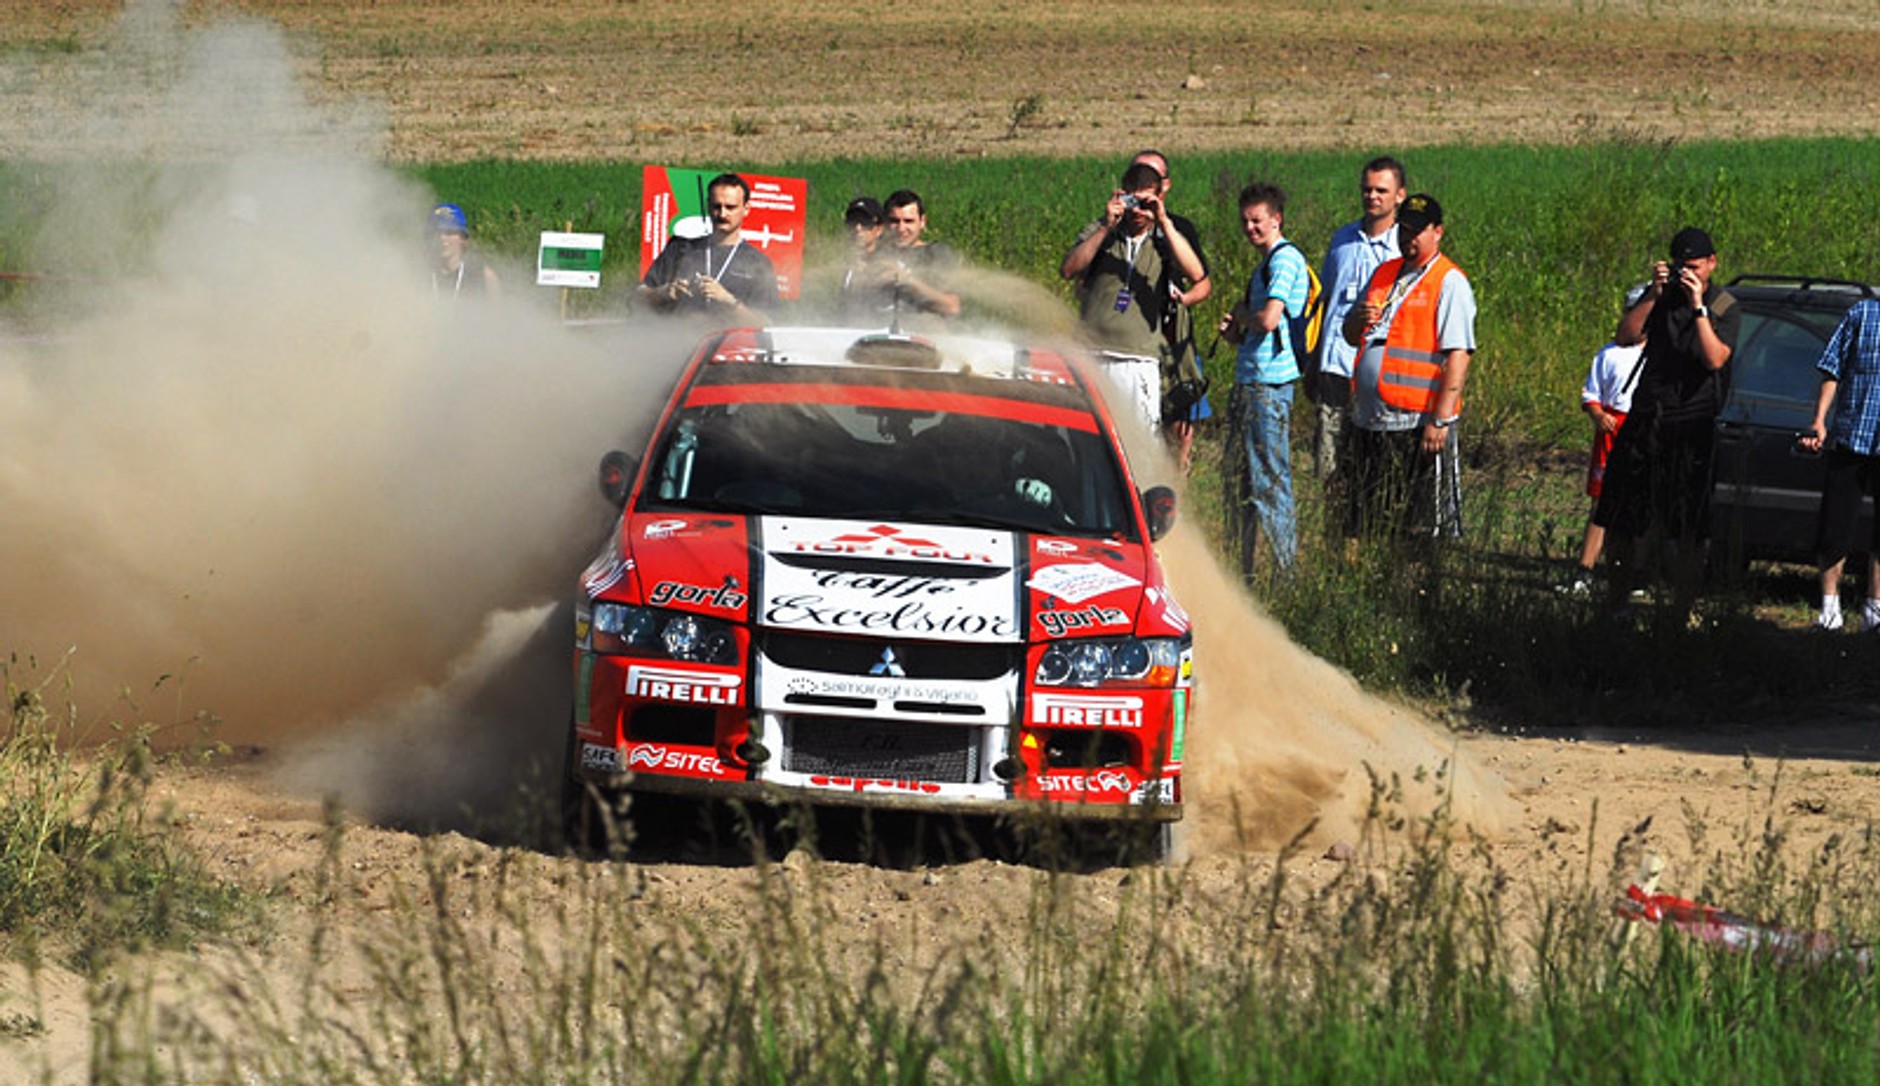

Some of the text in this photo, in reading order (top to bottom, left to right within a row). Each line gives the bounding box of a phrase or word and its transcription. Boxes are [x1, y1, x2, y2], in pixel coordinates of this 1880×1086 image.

[787, 541, 993, 564] TOP FOUR
[650, 577, 748, 611] gorla
[765, 594, 1018, 637] Excelsior
[1036, 605, 1132, 637] gorla
[625, 664, 742, 706] PIRELLI
[1031, 692, 1144, 728] PIRELLI
[1036, 775, 1101, 792] SITEC
